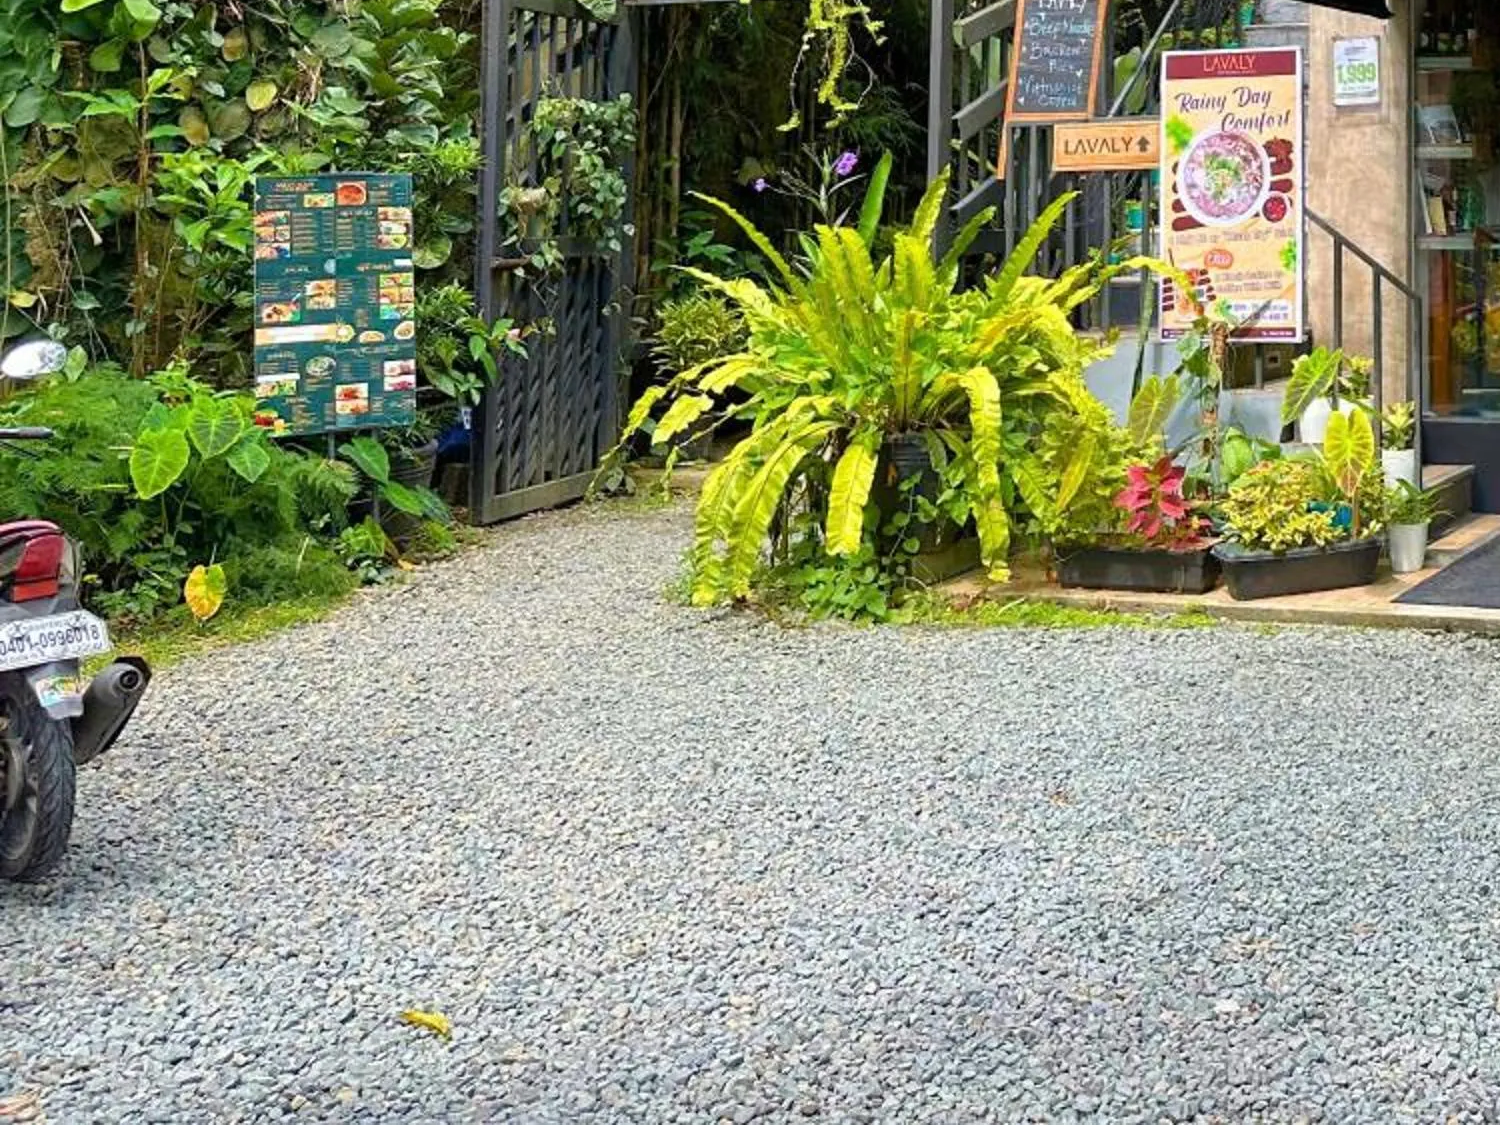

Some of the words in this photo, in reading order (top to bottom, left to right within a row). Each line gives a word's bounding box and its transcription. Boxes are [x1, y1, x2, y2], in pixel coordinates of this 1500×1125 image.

[1203, 55, 1257, 72] LAVALY
[1174, 92, 1227, 115] Rainy
[1232, 86, 1272, 109] Day
[1221, 109, 1291, 134] Comfort
[1064, 136, 1133, 155] LAVALY
